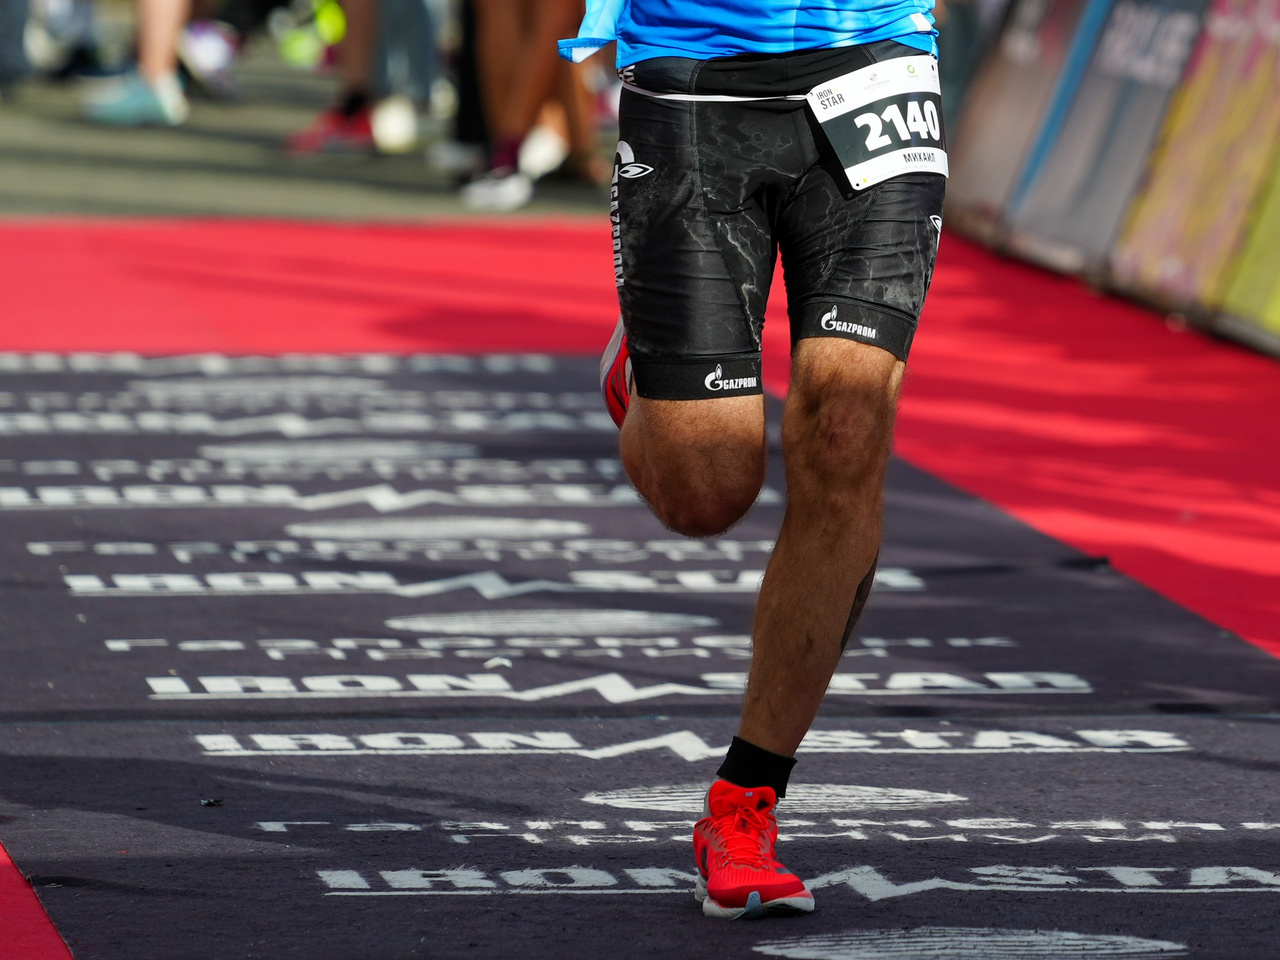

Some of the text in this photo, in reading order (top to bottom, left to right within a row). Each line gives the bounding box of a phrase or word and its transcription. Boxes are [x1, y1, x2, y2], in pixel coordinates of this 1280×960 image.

[816, 88, 834, 100] IRON
[820, 93, 846, 110] STAR
[853, 100, 940, 152] 2140
[836, 322, 876, 339] GAZPROM
[722, 377, 757, 391] GAZPROM
[145, 674, 513, 694] IRON
[195, 731, 585, 750] IRON
